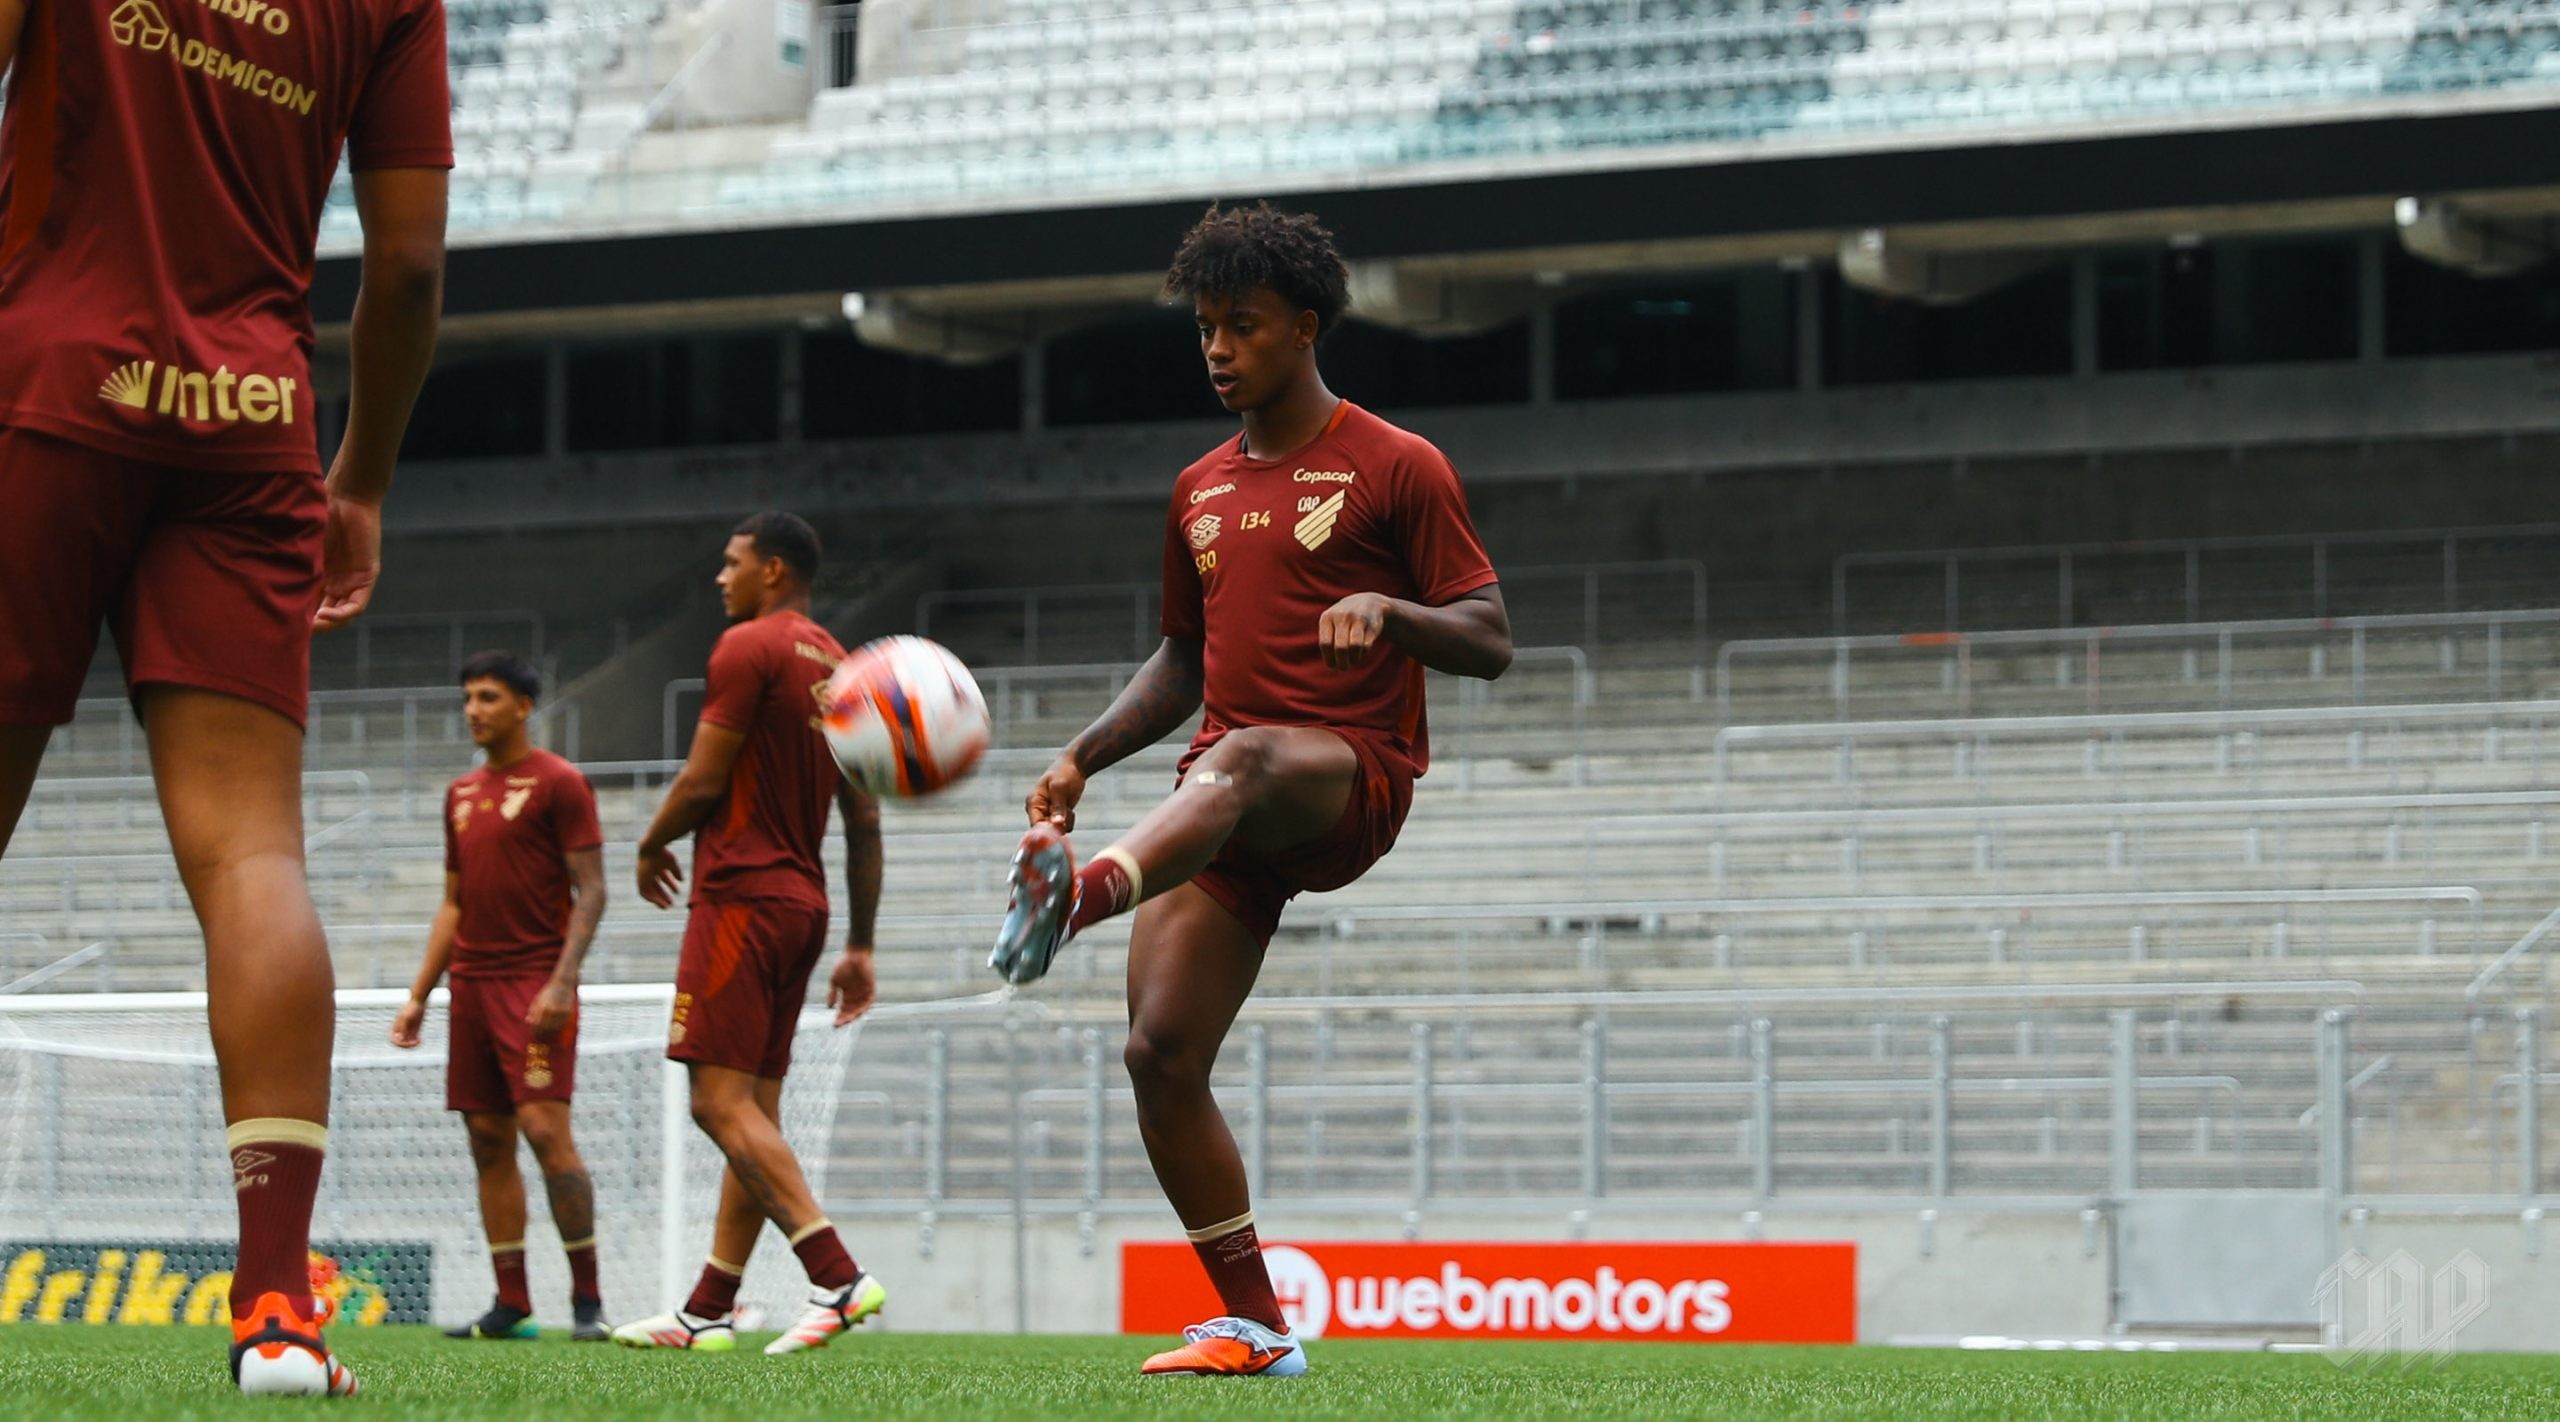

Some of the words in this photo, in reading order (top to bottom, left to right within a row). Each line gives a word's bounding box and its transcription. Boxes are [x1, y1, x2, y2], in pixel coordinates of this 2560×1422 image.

[1293, 467, 1356, 484] Copacol
[1240, 510, 1271, 530] 134
[1335, 1260, 1733, 1334] webmotors
